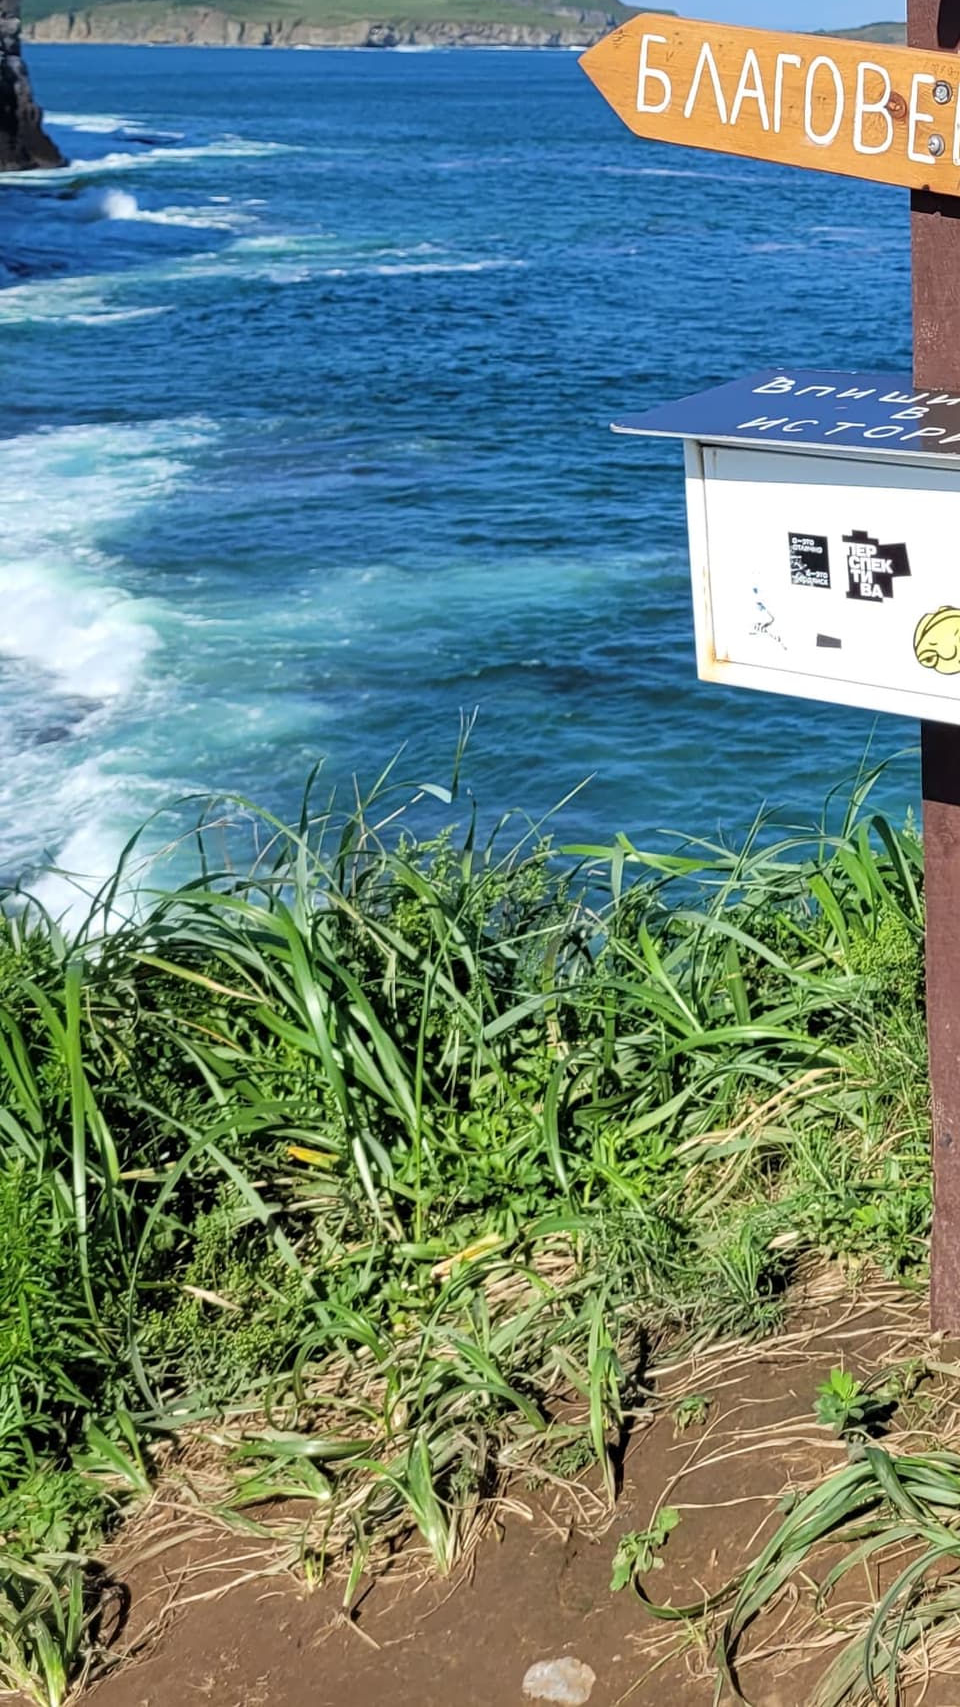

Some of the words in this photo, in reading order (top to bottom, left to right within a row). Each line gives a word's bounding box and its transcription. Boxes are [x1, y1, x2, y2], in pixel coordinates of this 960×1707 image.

[889, 404, 931, 421] В
[848, 555, 894, 575] СПЕК
[850, 569, 874, 584] ТИ
[860, 583, 884, 599] ВА
